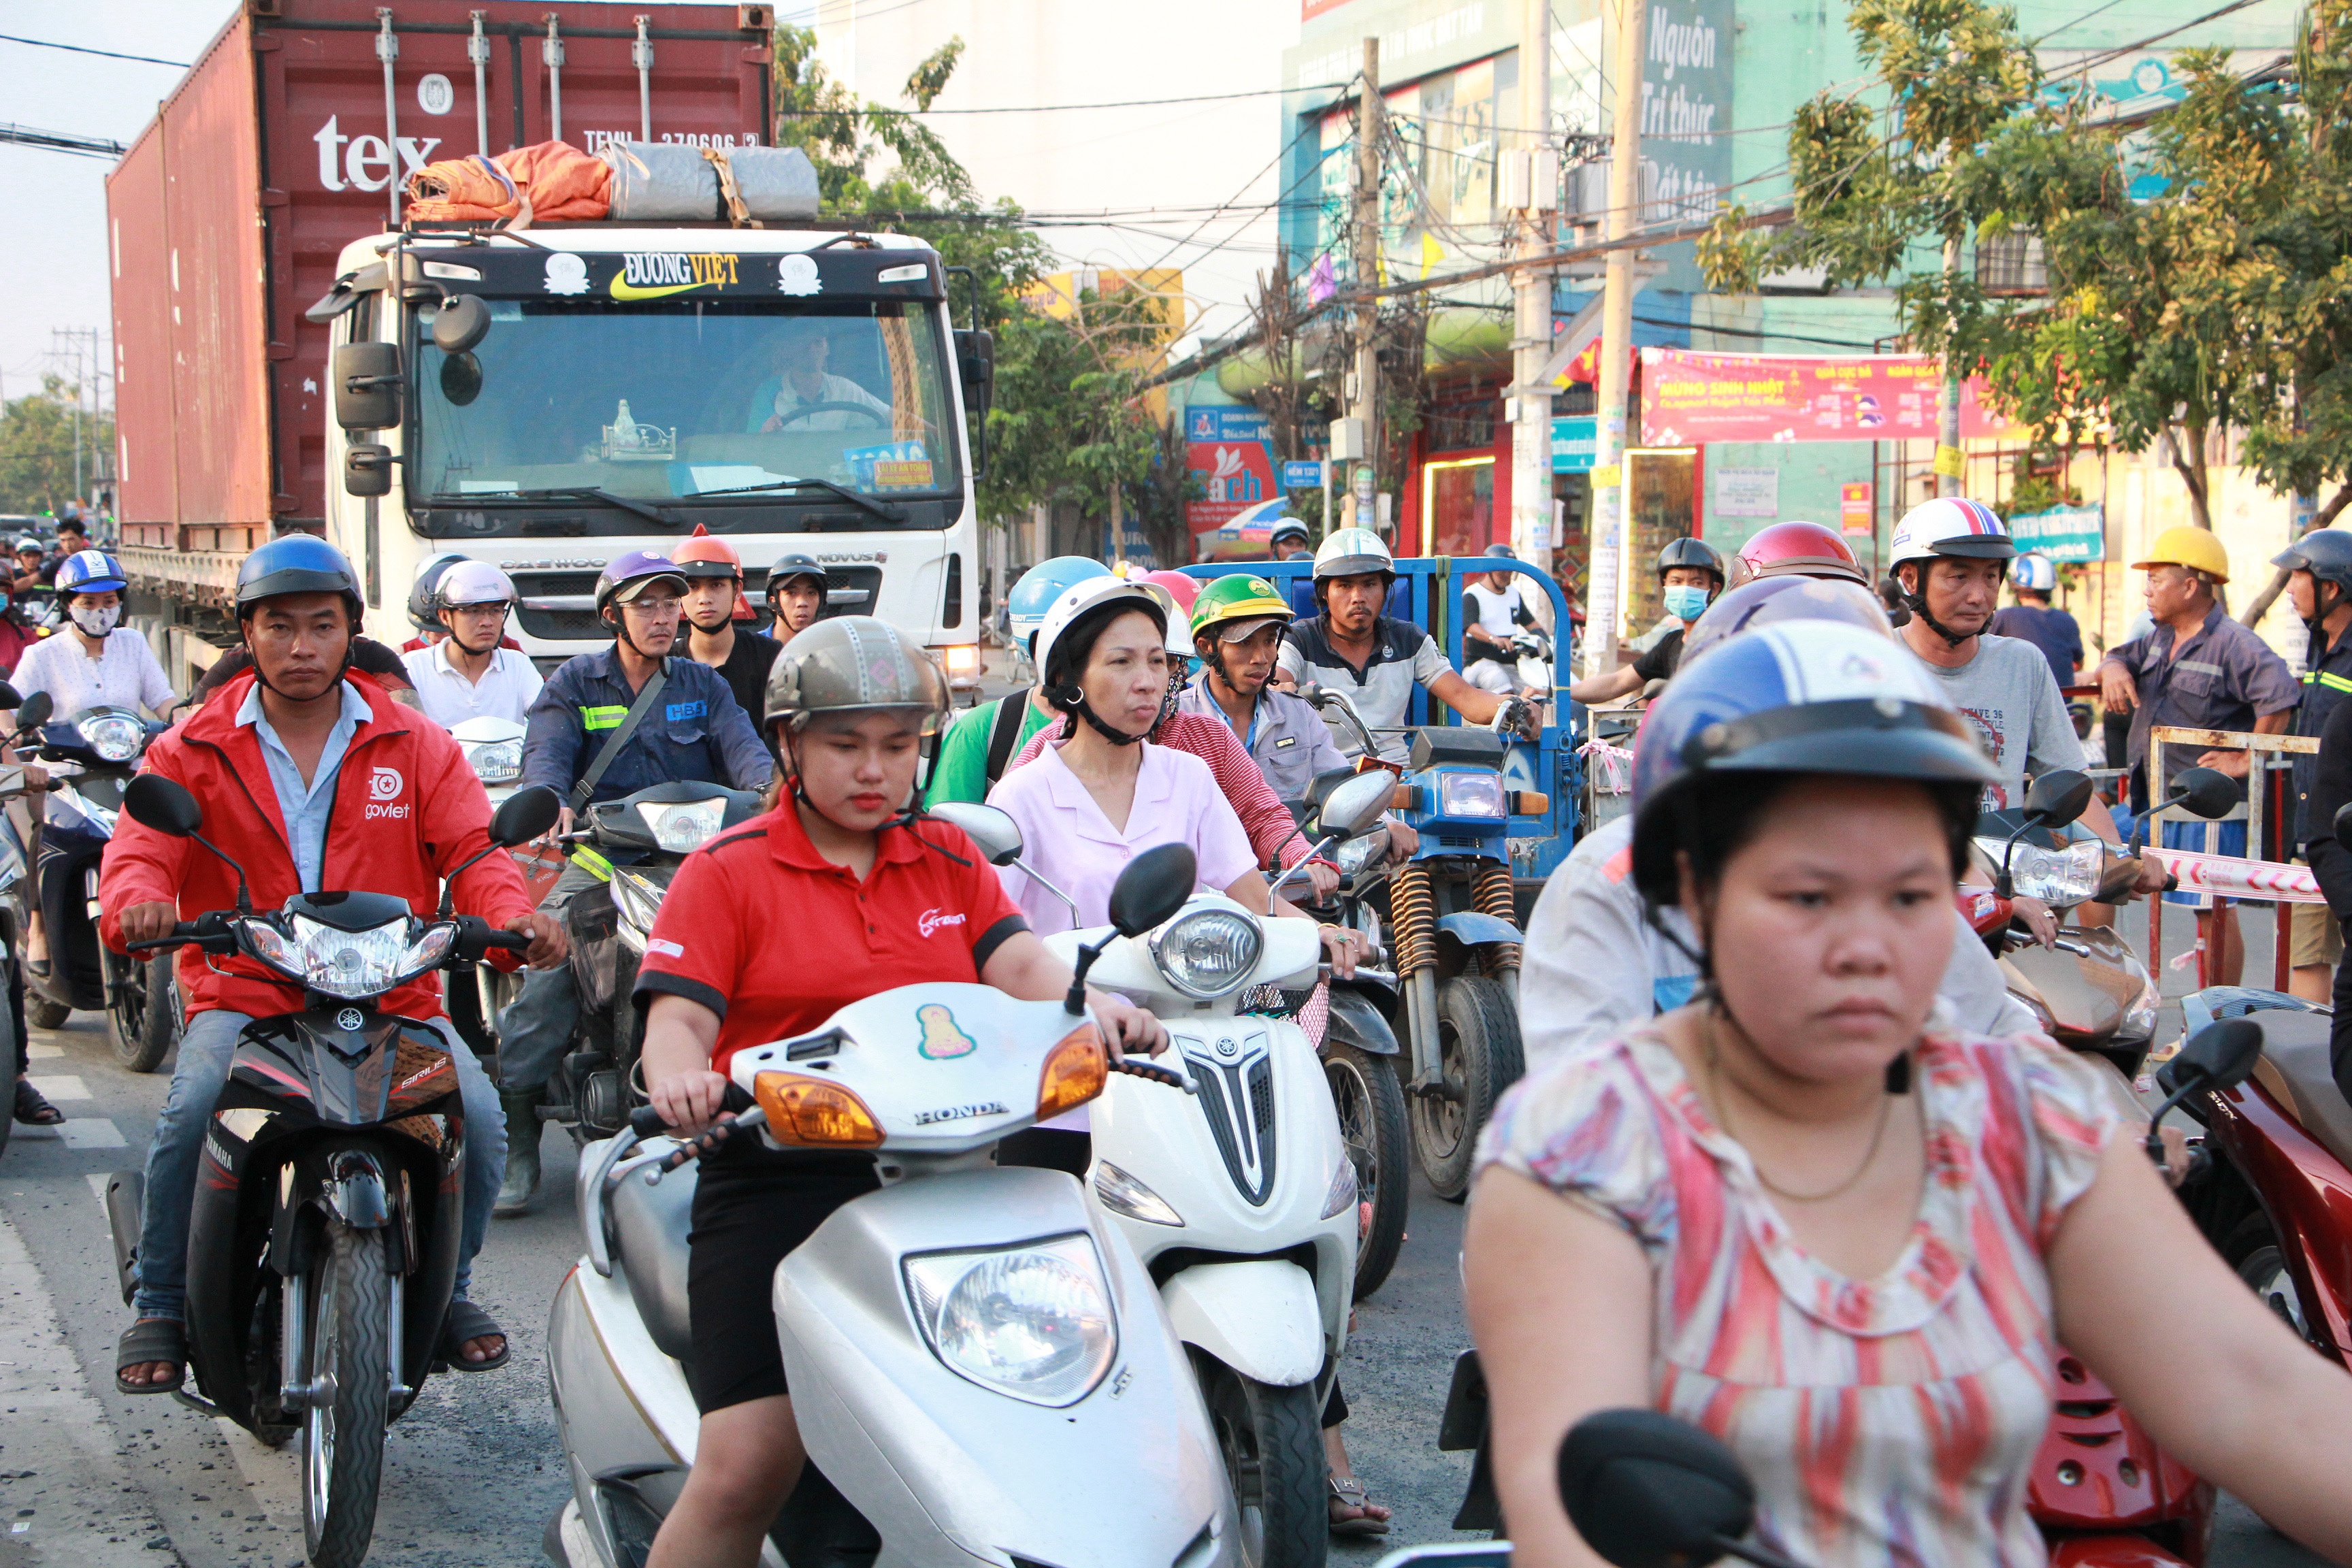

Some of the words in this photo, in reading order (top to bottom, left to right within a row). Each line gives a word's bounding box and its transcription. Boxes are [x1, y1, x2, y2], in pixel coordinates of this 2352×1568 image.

[313, 114, 442, 192] tex
[500, 558, 607, 569] DAEWOO
[817, 552, 873, 562] NOVUS
[1993, 710, 2003, 719] 36
[365, 802, 410, 819] goviet
[402, 1057, 446, 1089] SIRIUS
[915, 1101, 1010, 1125] HONDA
[206, 1131, 233, 1171] YAMAHA
